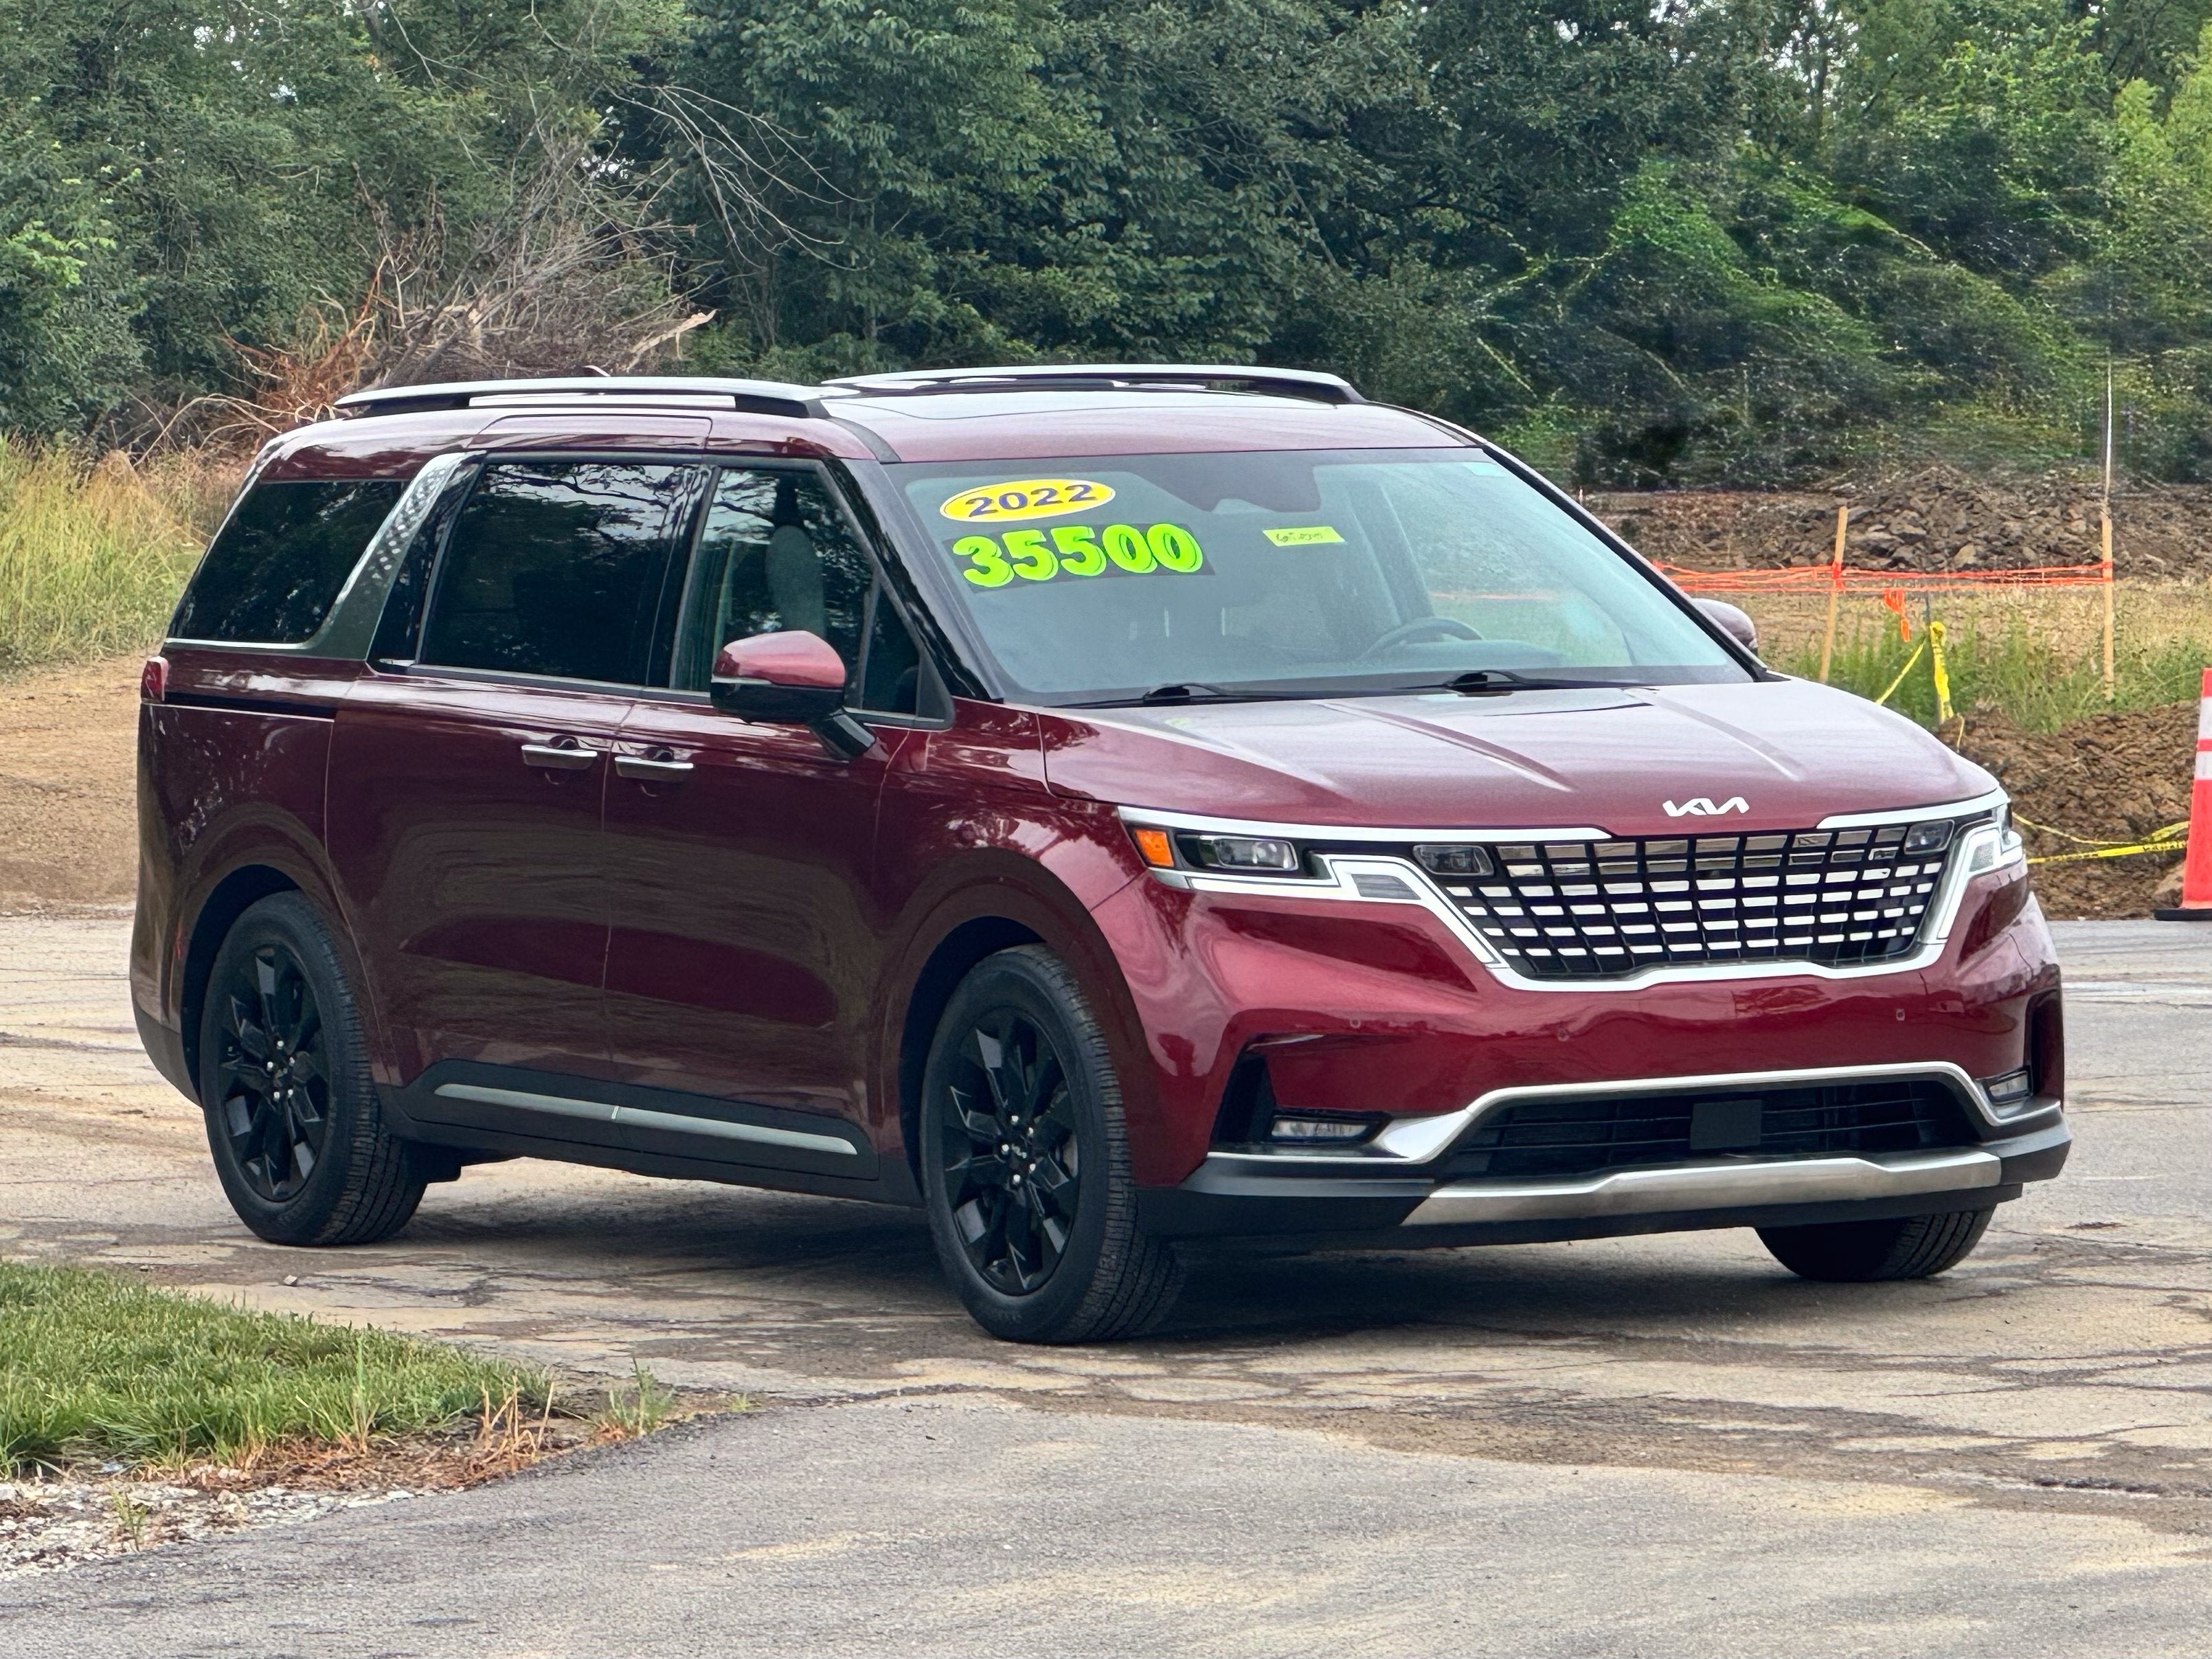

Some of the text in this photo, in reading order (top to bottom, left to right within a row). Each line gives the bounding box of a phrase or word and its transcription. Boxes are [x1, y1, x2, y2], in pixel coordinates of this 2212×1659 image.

[967, 484, 1096, 517] 2022
[953, 523, 1203, 587] 35500
[1662, 797, 1750, 817] KIA
